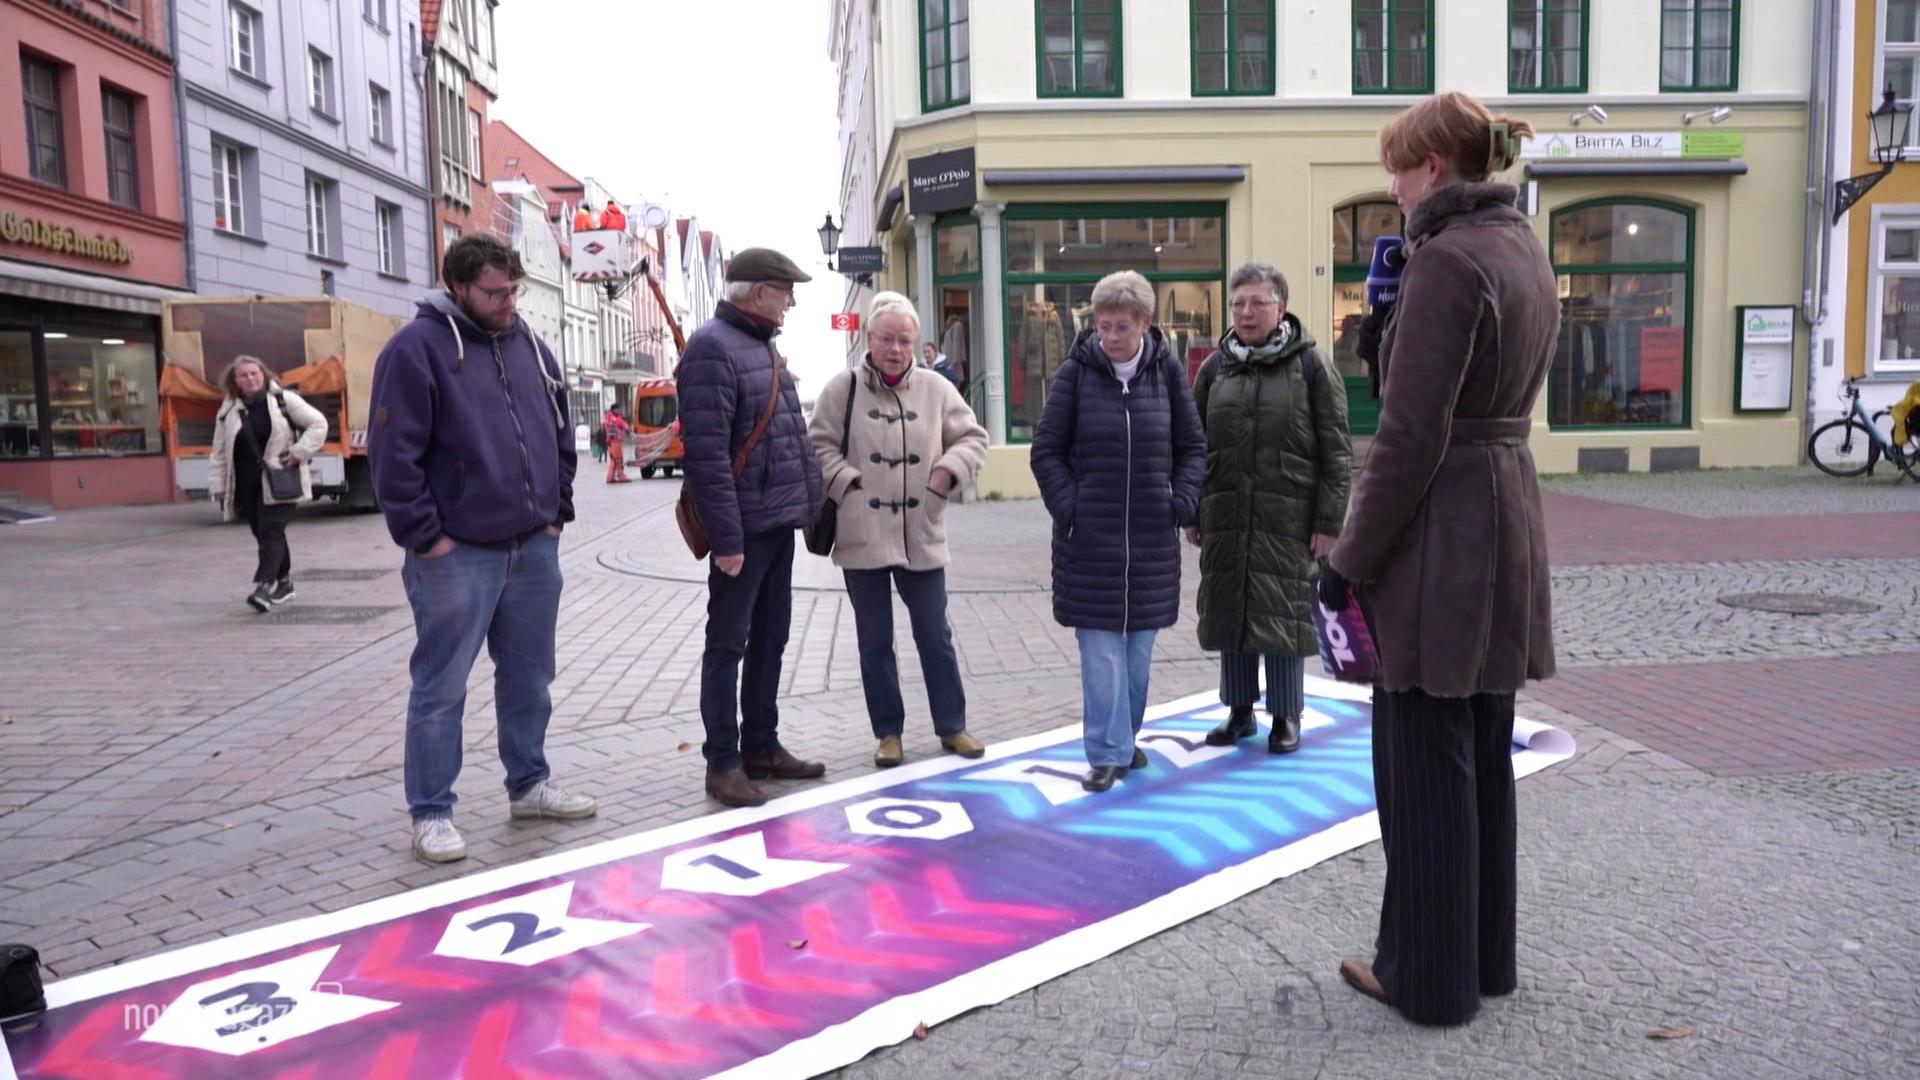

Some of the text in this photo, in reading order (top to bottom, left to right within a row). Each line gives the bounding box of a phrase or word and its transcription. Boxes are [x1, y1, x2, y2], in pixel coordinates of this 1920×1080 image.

[913, 176, 937, 187] Marc
[939, 168, 970, 182] O'Polo
[866, 804, 942, 829] 0
[687, 853, 763, 880] 1
[466, 912, 567, 955] 2
[198, 982, 297, 1036] 3
